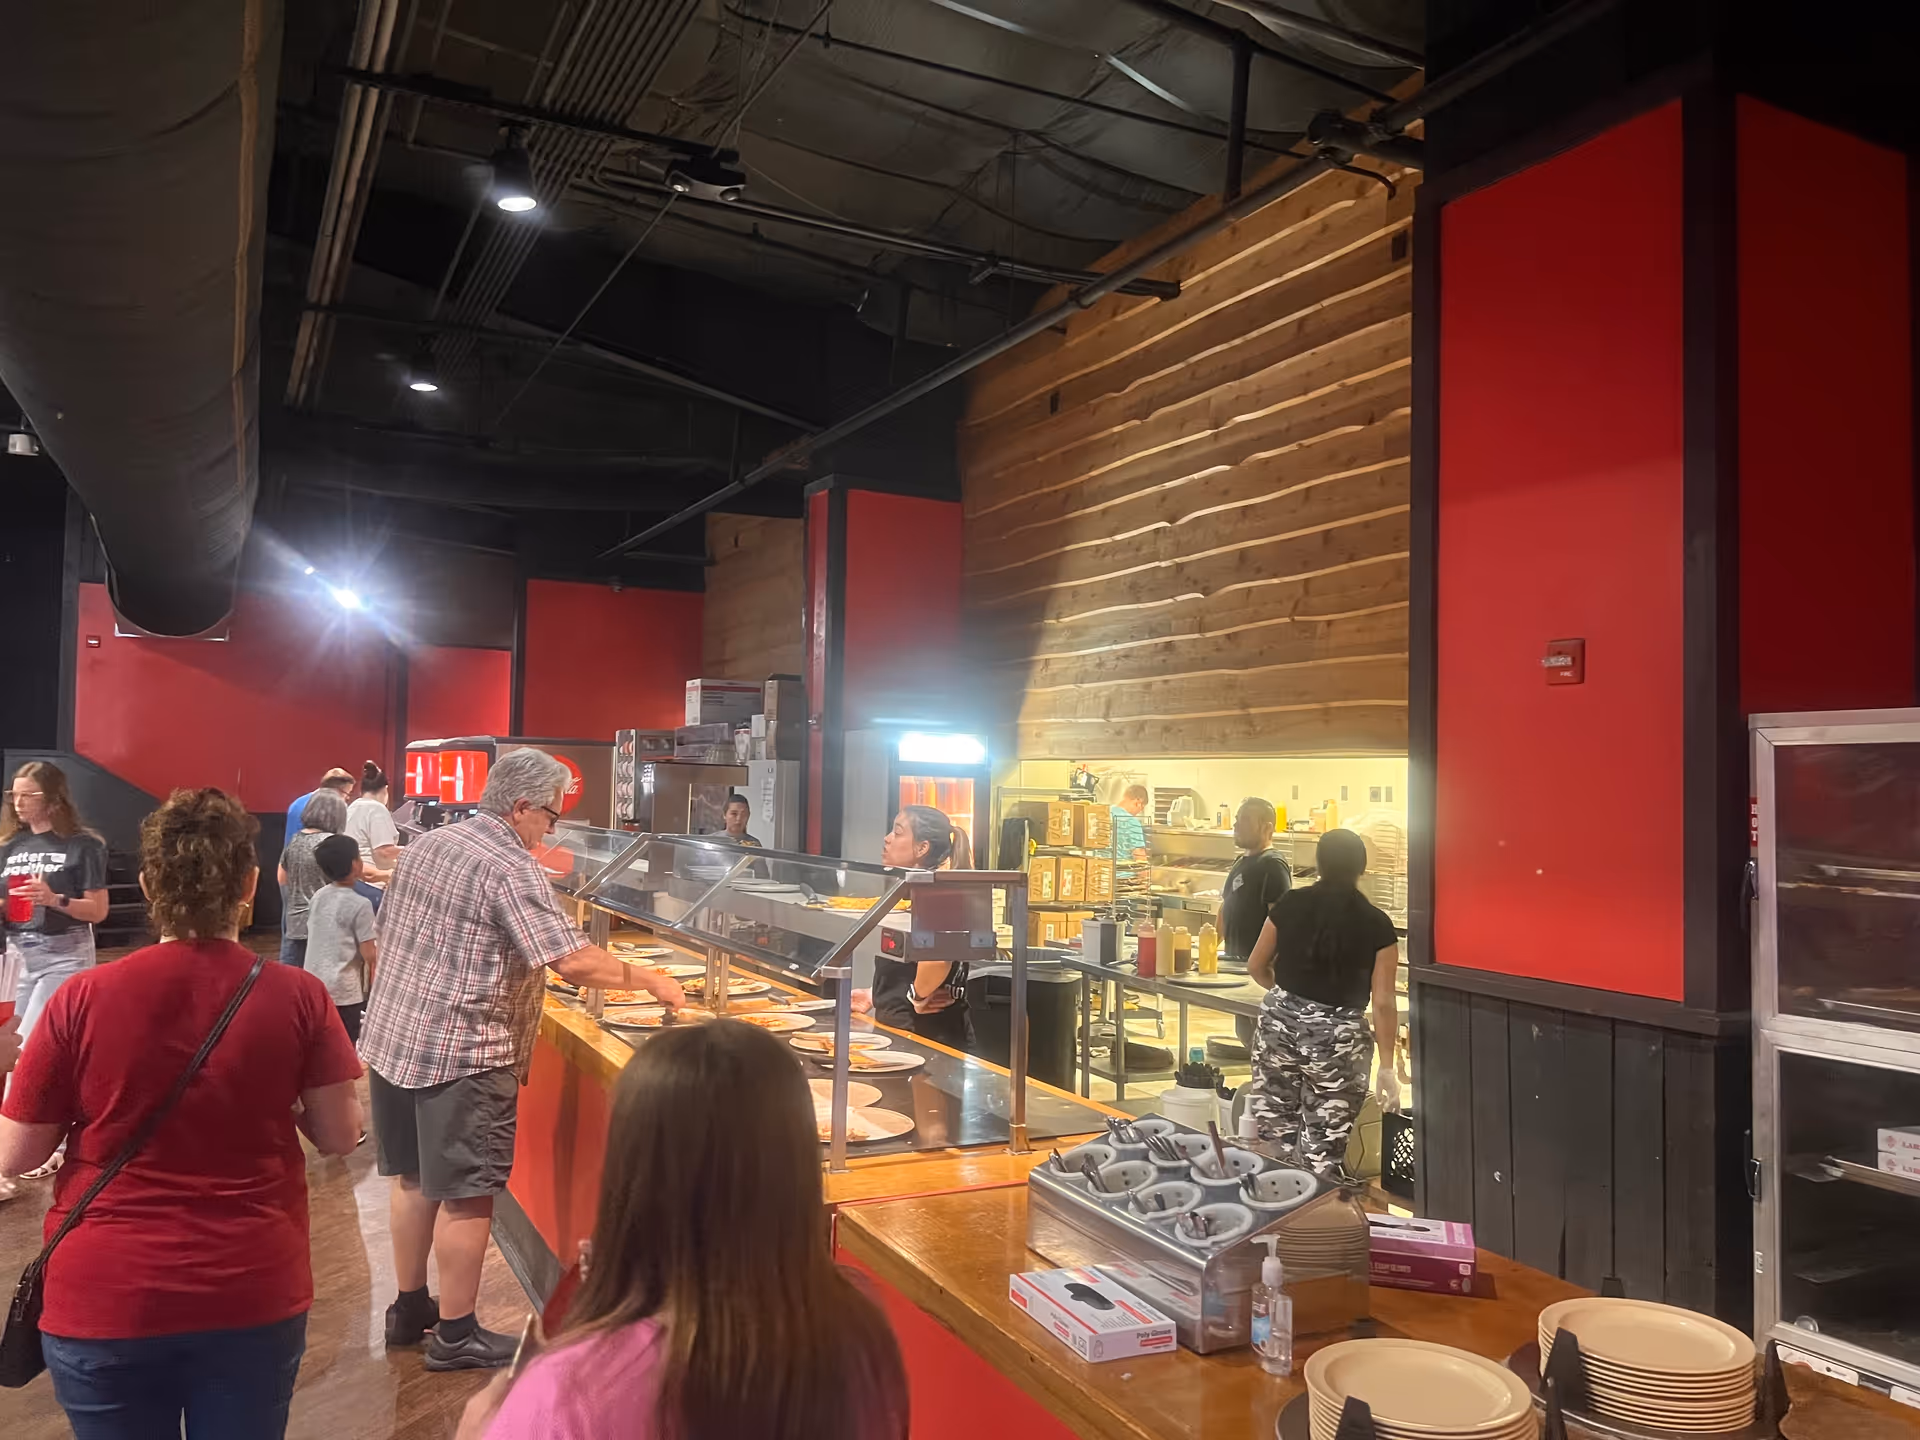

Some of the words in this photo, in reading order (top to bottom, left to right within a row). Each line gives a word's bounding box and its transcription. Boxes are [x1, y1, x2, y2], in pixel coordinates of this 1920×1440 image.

[1751, 804, 1759, 841] HOT
[7, 852, 45, 863] etter
[1, 862, 64, 877] ogether.
[1902, 1141, 1920, 1149] LAR
